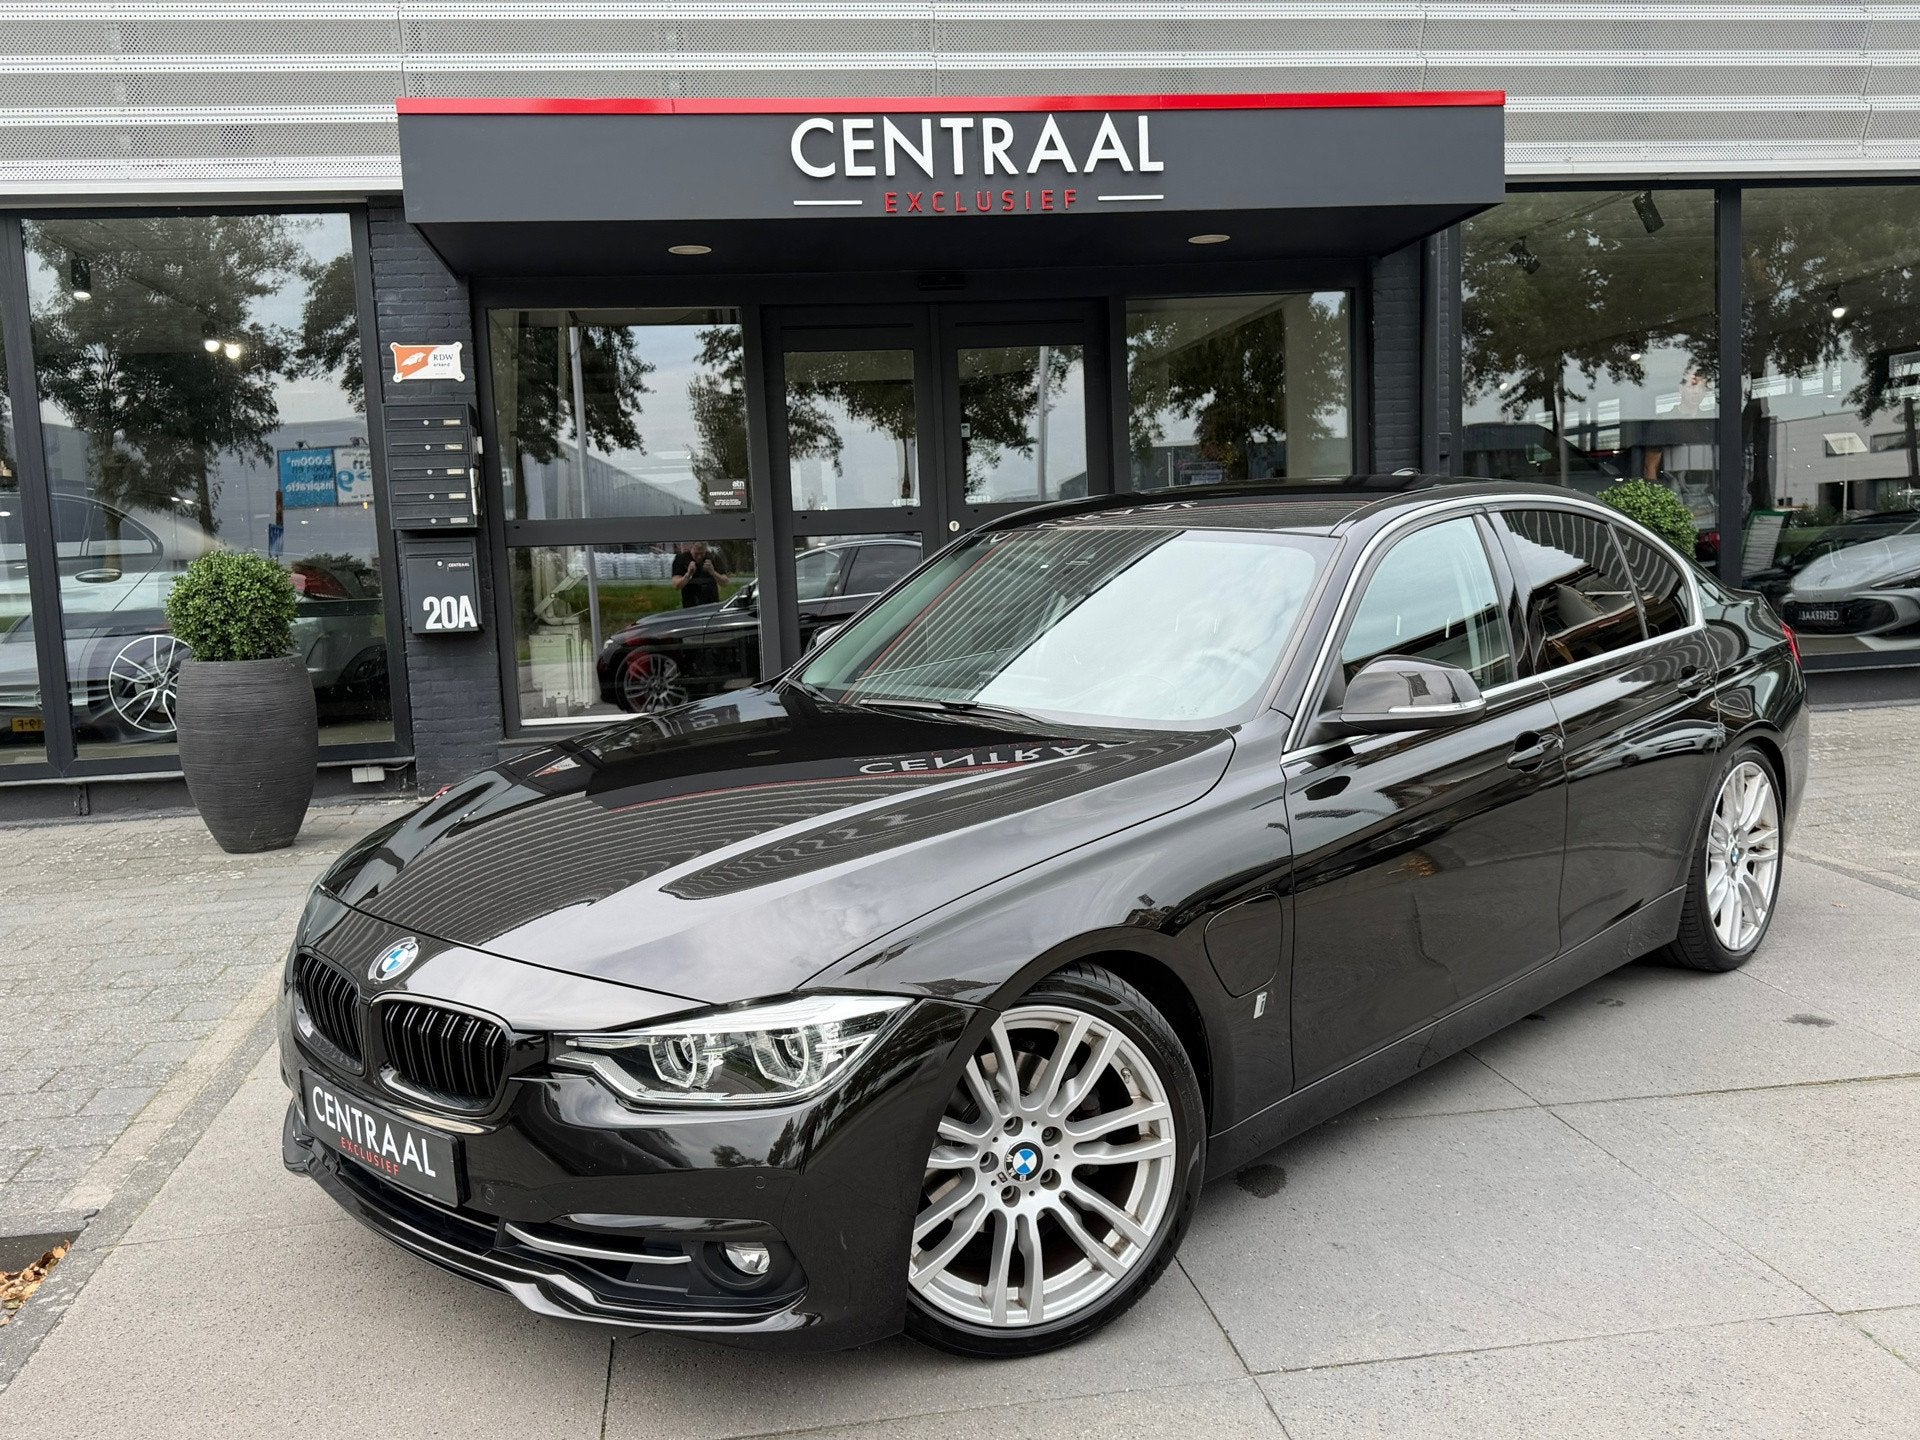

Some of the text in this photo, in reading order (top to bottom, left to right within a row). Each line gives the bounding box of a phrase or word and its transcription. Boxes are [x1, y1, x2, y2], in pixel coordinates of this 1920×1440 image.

[790, 112, 1164, 179] CENTRAAL
[884, 189, 1078, 213] EXCLUSIEF
[433, 353, 454, 361] RDW
[423, 595, 478, 630] 20A
[312, 1085, 436, 1178] CENTRAAL
[340, 1136, 400, 1177] EXCLUSIEF
